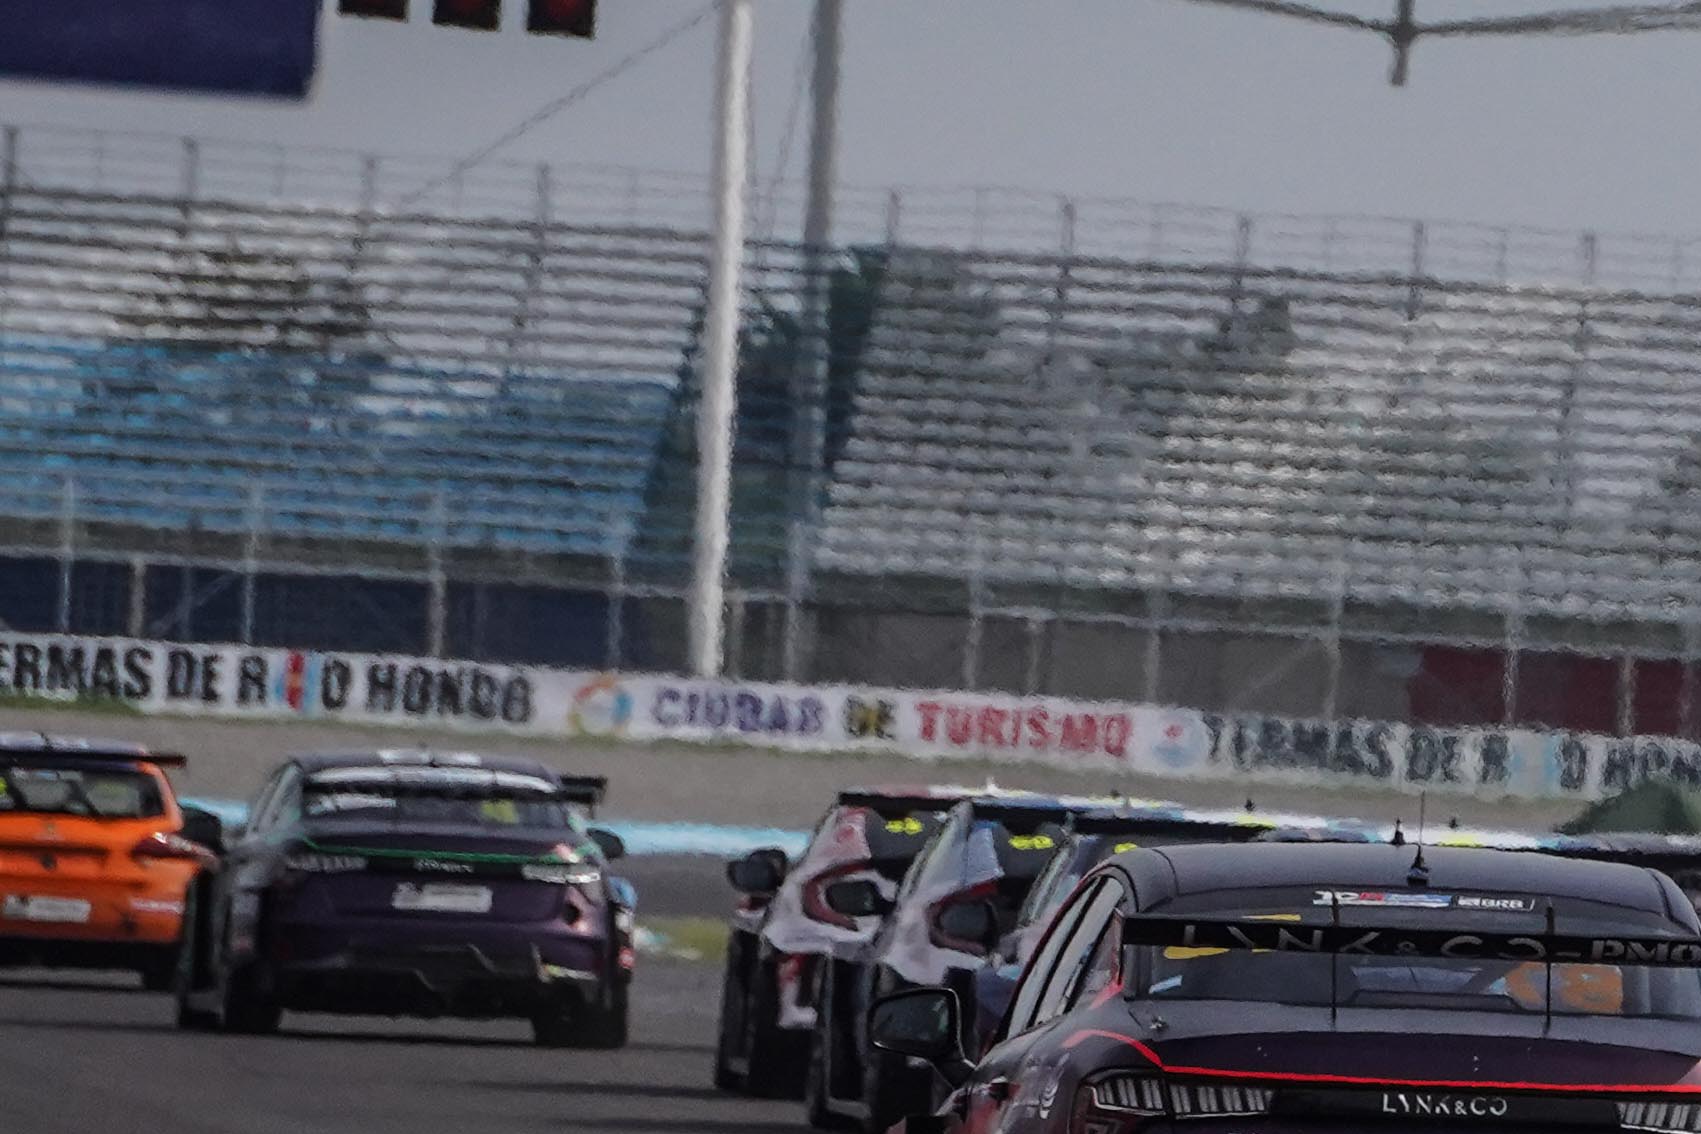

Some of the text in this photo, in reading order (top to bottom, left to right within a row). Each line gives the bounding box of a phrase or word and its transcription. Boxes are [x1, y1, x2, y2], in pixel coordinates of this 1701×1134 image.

[167, 650, 224, 701] DE
[366, 662, 536, 722] HONDO
[652, 686, 825, 736] CIUDAD
[913, 702, 1132, 758] TURISMO
